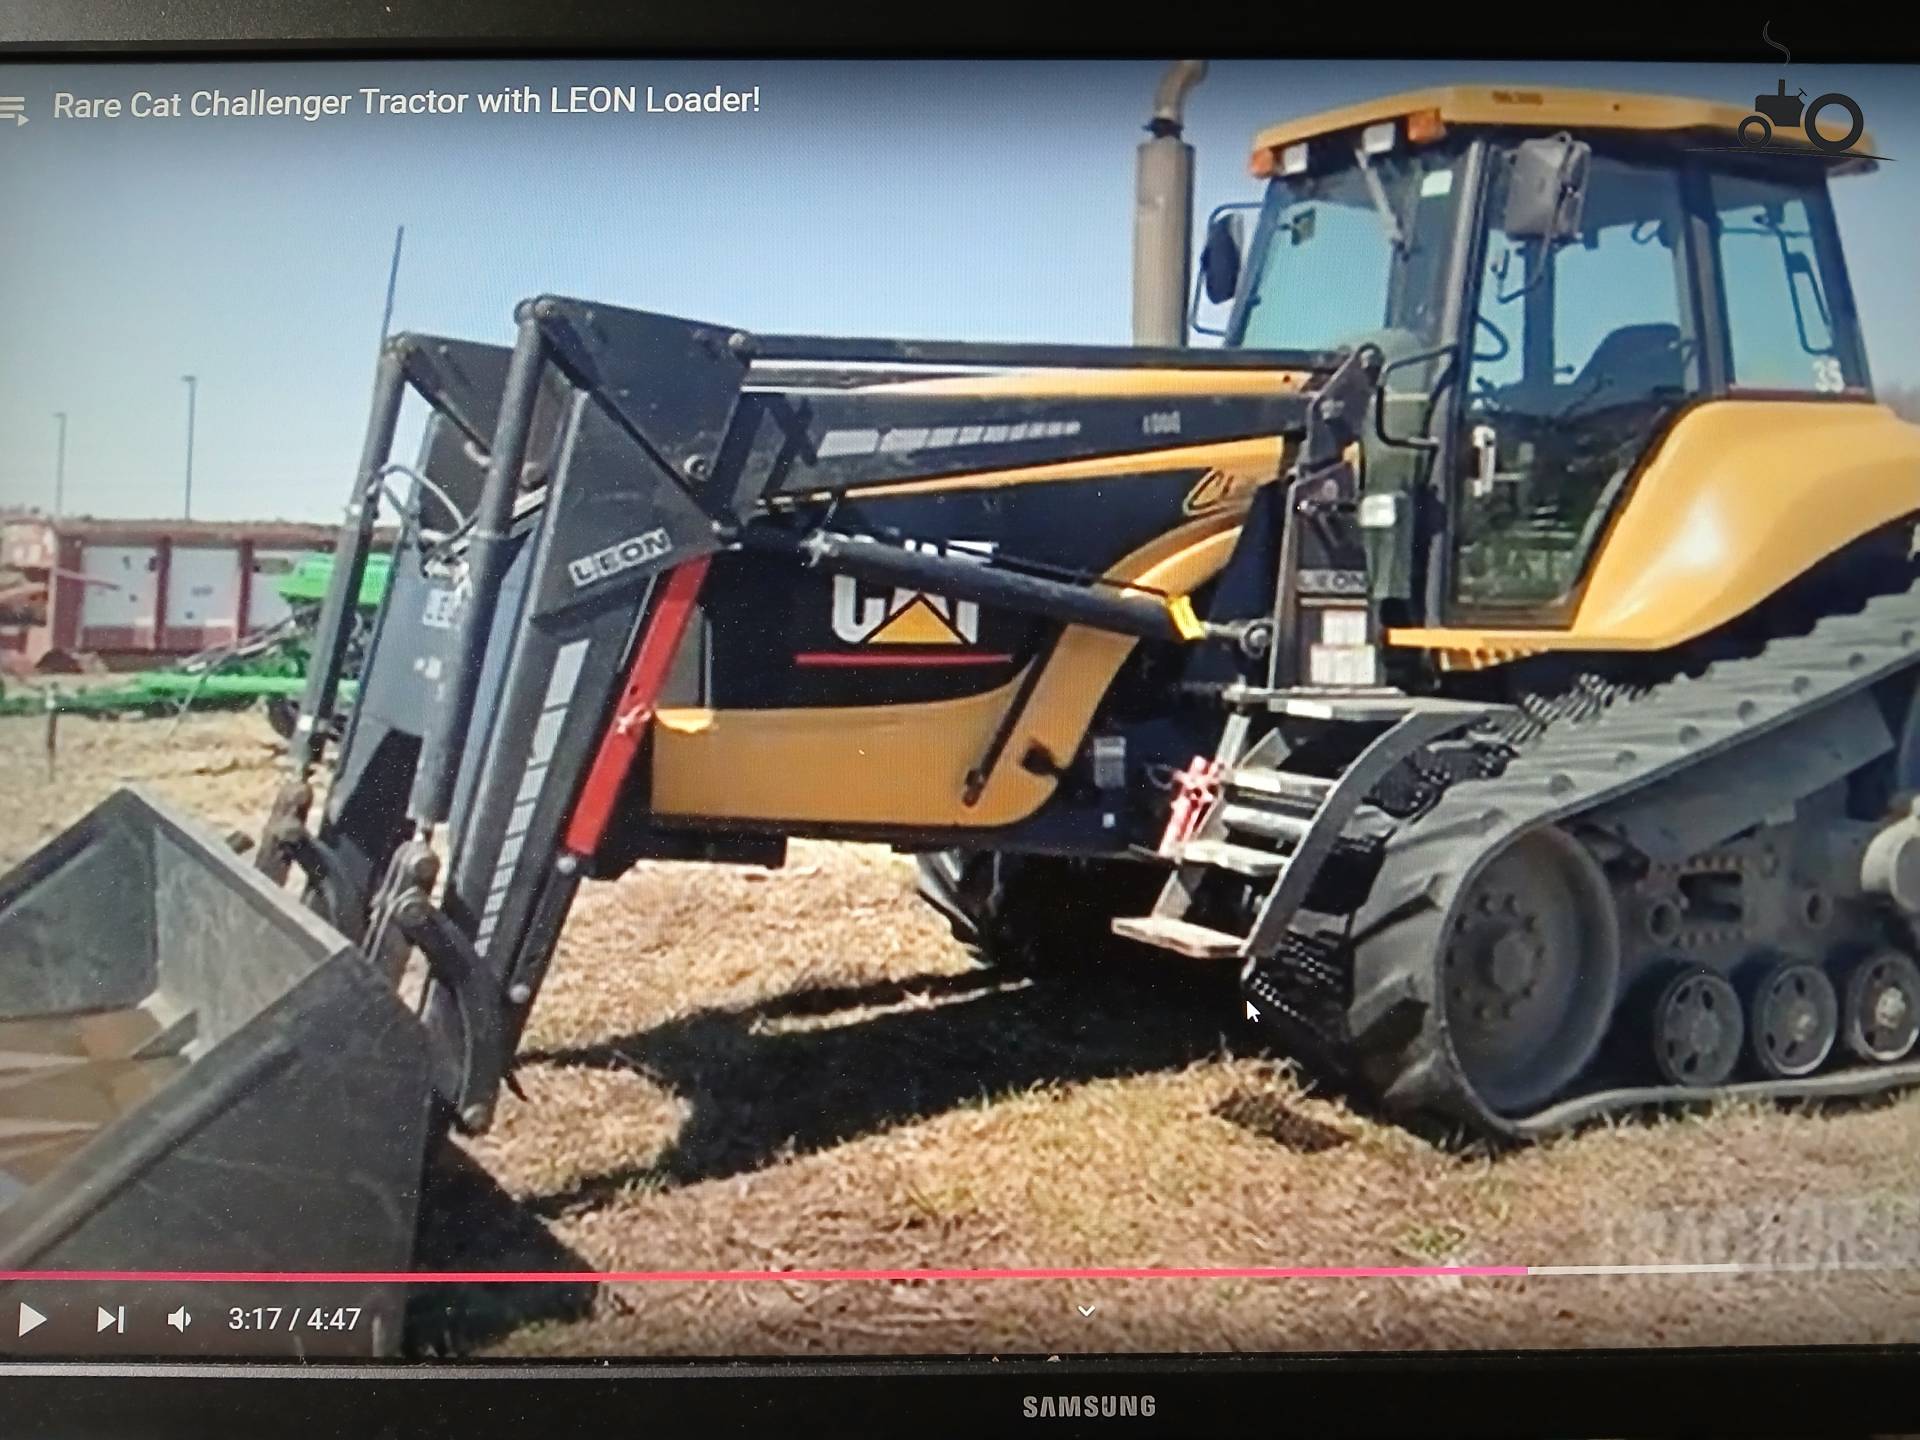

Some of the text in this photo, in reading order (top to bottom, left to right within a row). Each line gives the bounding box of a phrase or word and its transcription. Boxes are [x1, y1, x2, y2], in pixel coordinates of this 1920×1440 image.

[54, 86, 761, 122] Rare Cat Challenger Tractor with LEON Loader!
[570, 528, 670, 584] LEON
[228, 1307, 362, 1332] 3:17 / 4:47
[1022, 1395, 1156, 1419] SAMSUNG
